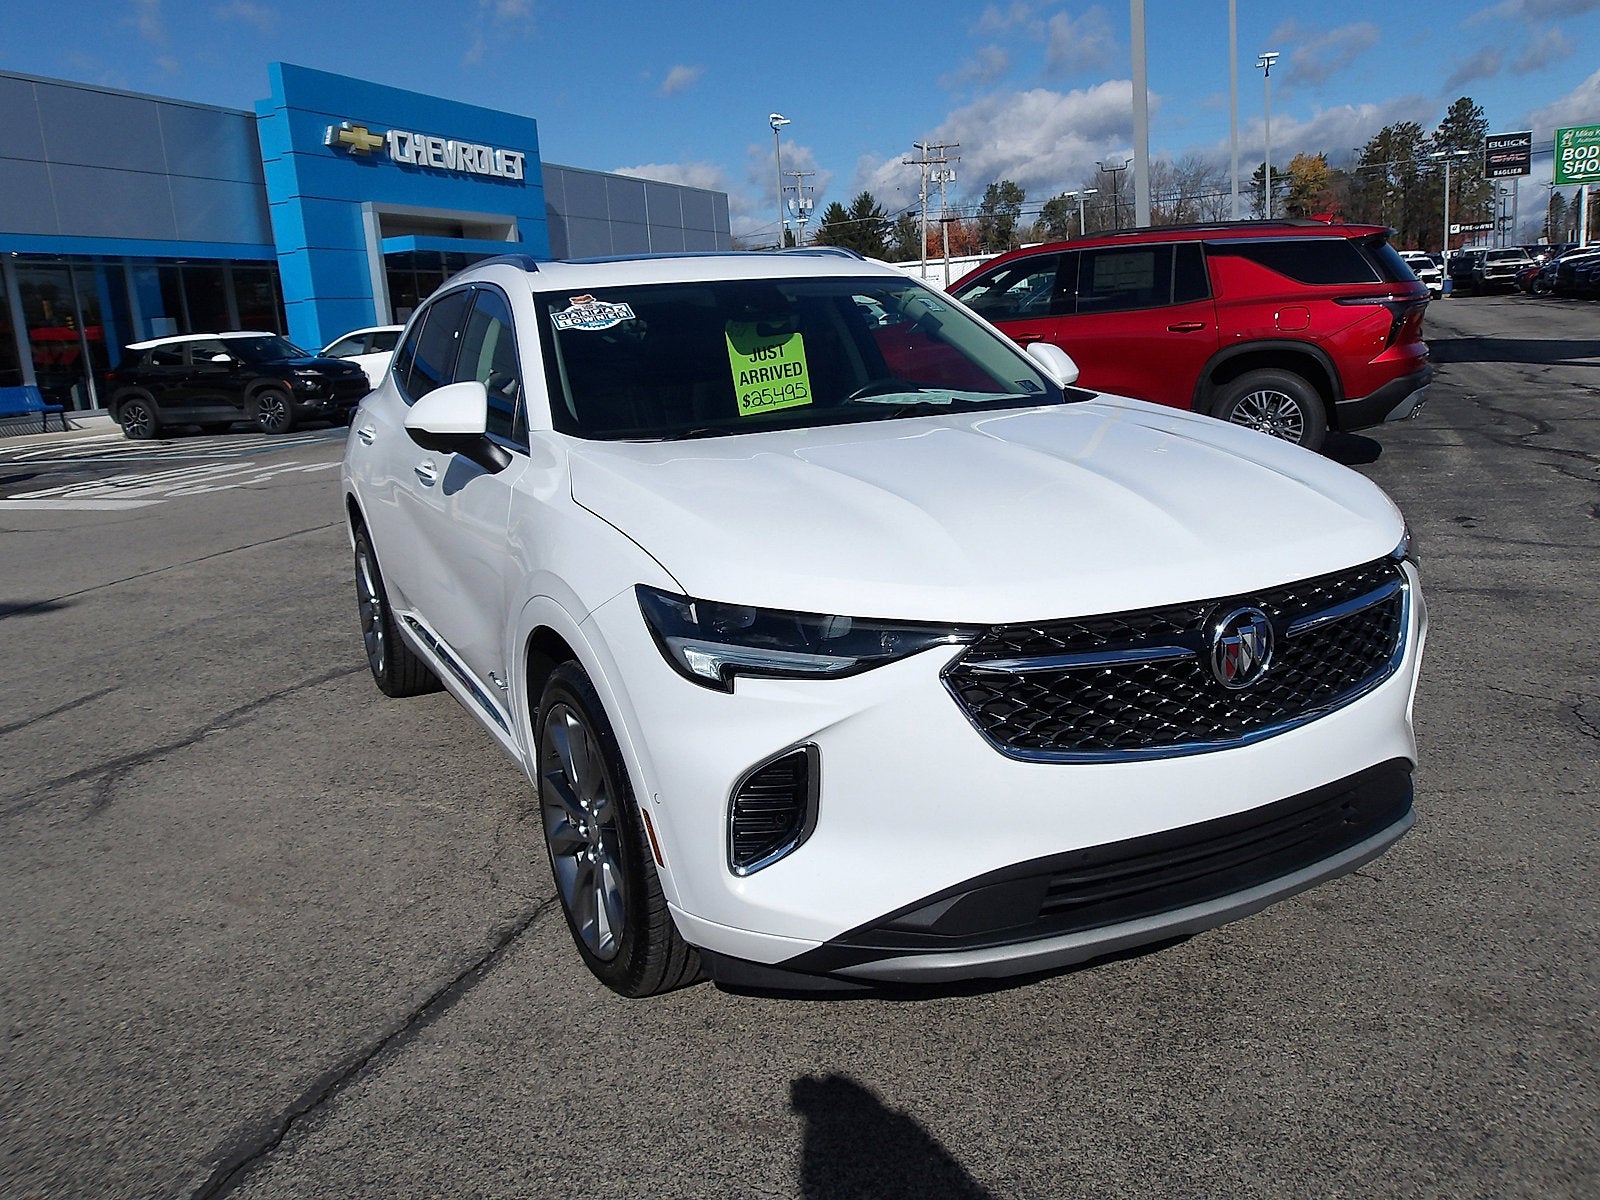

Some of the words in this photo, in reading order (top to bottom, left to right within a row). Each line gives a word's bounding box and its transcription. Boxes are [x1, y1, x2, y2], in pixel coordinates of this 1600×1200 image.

[1489, 138, 1529, 148] BUICK
[387, 129, 525, 180] CHEVROLET
[1562, 145, 1600, 160] BOD
[1562, 158, 1600, 174] SHO
[1460, 223, 1494, 231] PRE-OWNE
[558, 305, 626, 321] CARFAX
[749, 344, 785, 363] JUST
[740, 361, 803, 386] ARRIVED
